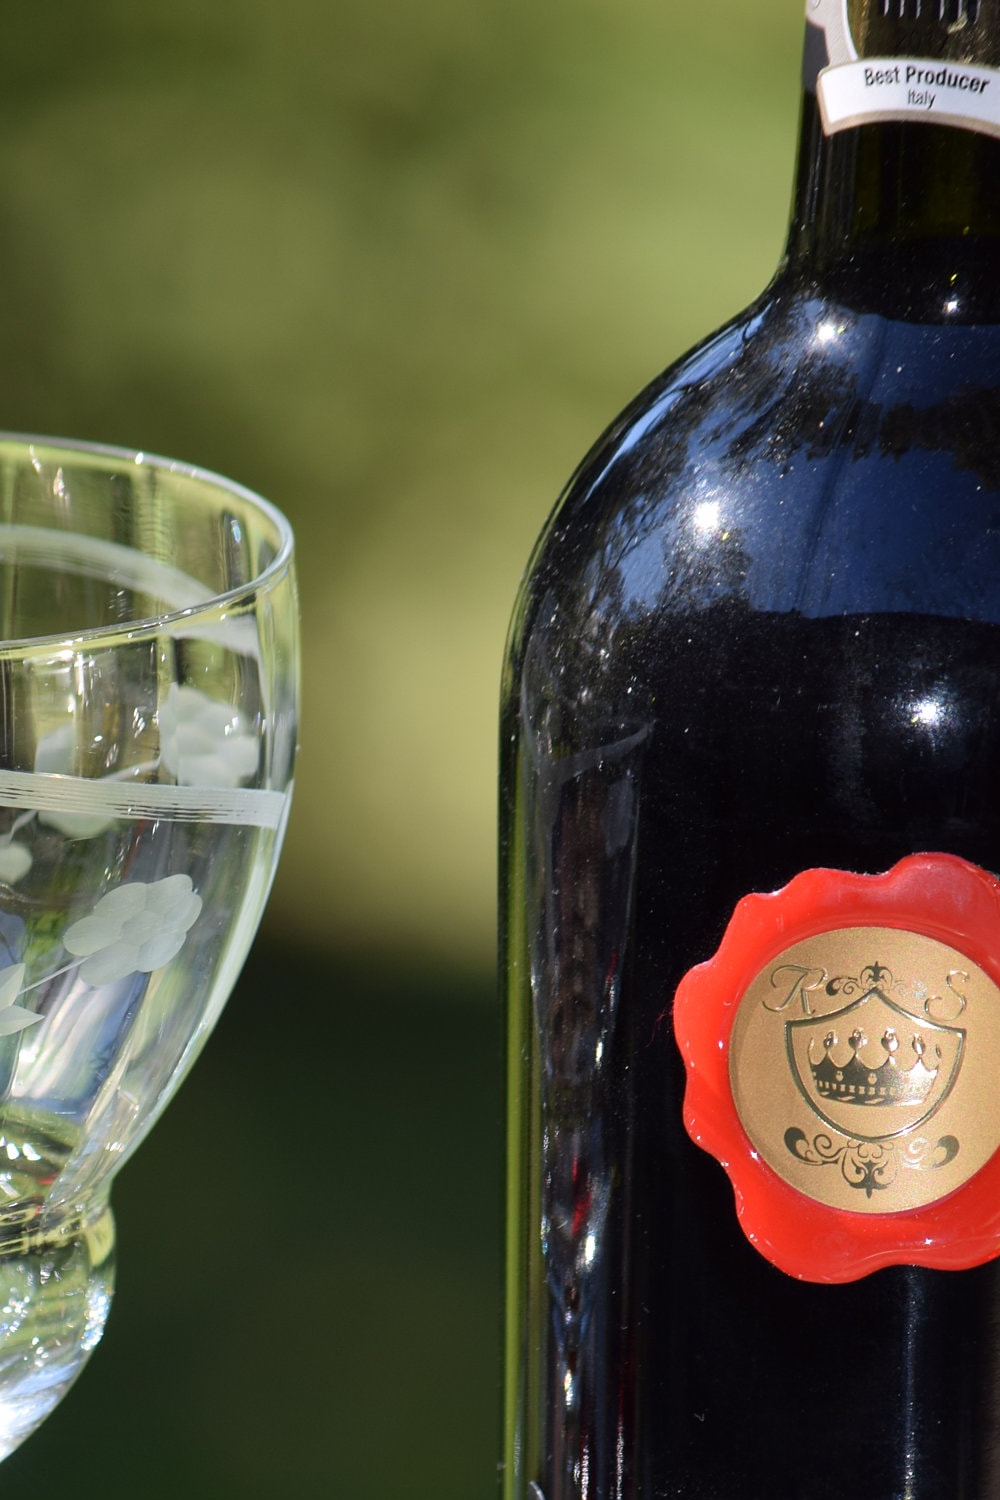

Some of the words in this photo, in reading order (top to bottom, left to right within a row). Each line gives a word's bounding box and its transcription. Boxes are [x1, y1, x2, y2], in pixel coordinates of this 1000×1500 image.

[864, 67, 901, 87] Best
[905, 66, 991, 95] Producer
[907, 89, 937, 110] Italy
